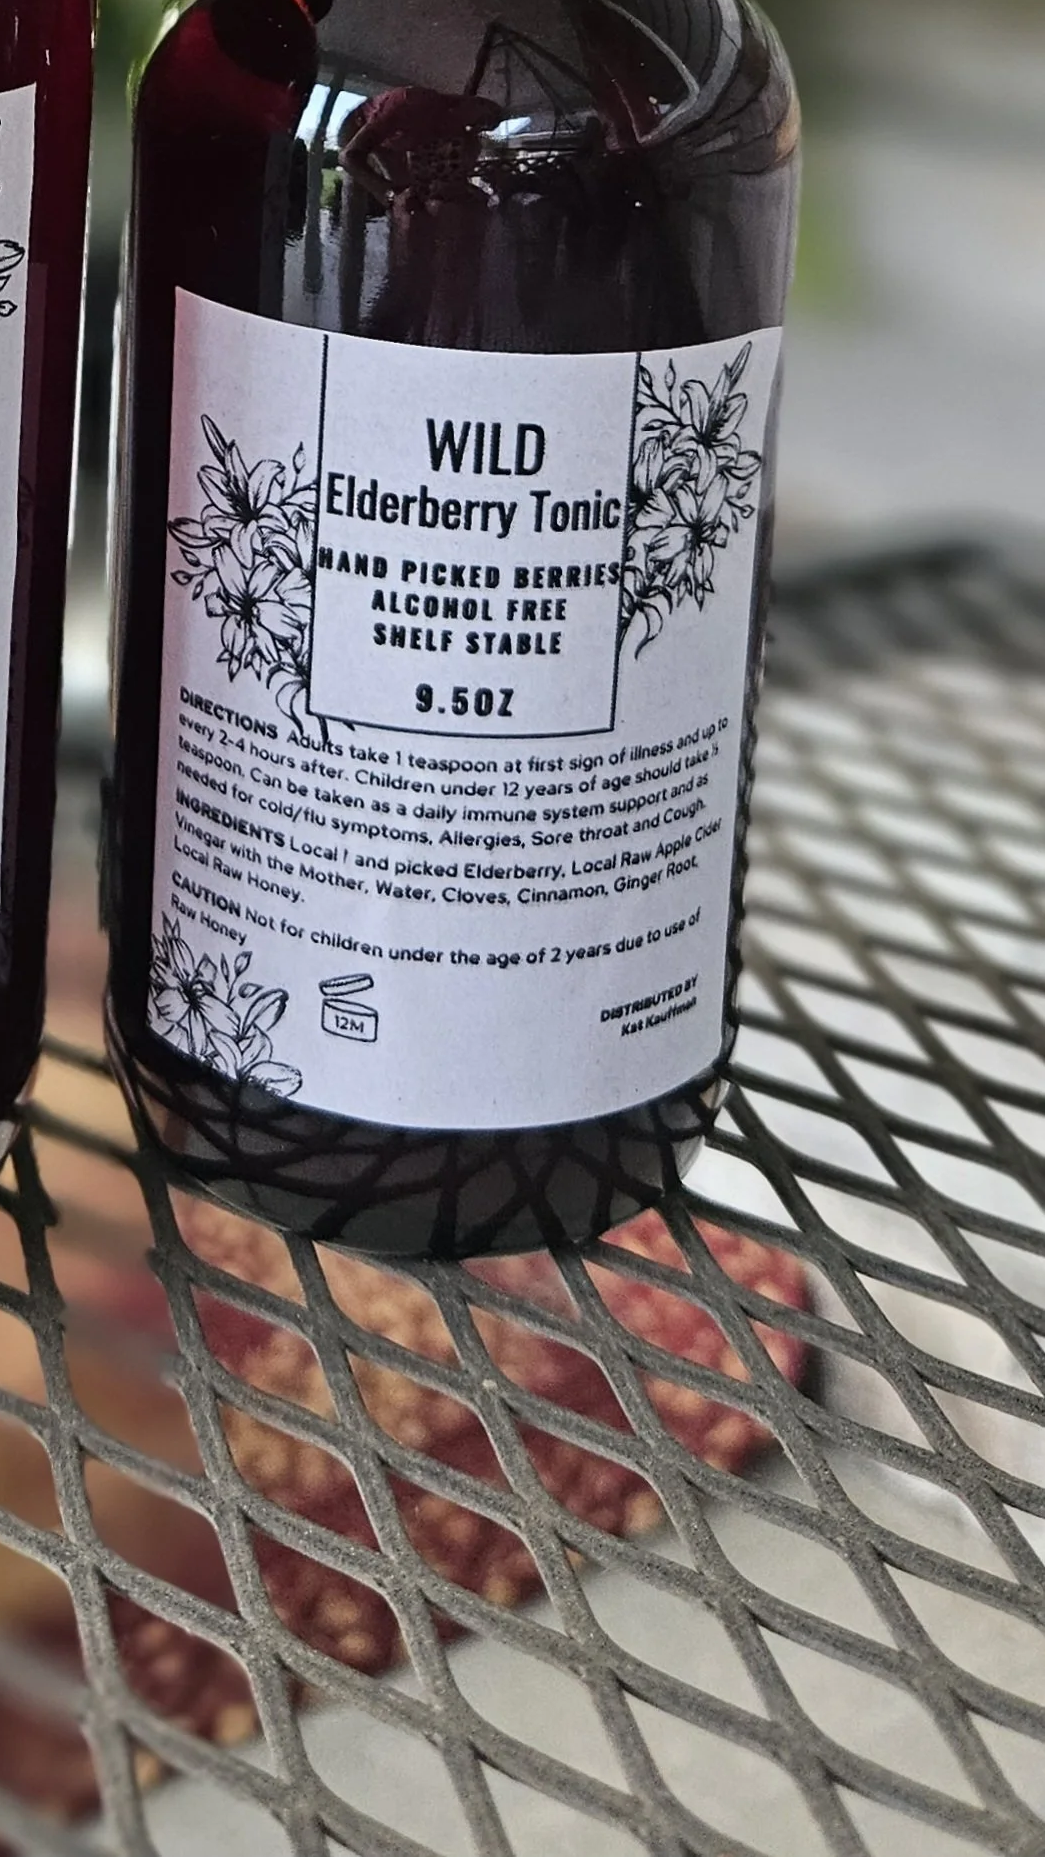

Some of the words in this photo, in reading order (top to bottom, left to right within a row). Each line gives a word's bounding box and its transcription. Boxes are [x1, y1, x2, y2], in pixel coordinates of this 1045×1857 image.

[426, 418, 546, 476] WILD
[325, 472, 518, 538] Elderberry
[531, 488, 622, 535] Tonic
[318, 546, 388, 579] HAND
[400, 561, 501, 588] PICKED
[514, 561, 622, 590] BERRIES
[371, 590, 494, 621] ALCOHOL
[507, 598, 567, 622] FREE
[373, 623, 454, 652] SHELF
[466, 630, 562, 655] STABLE
[177, 759, 227, 795] needed
[231, 783, 254, 804] for
[259, 796, 326, 826] cold/flu
[531, 828, 573, 846] Sore
[579, 821, 628, 843] throat
[633, 812, 660, 833] and
[174, 835, 209, 867] Local
[213, 856, 243, 881] Raw
[175, 810, 226, 849] Vinegar
[230, 842, 262, 864] with
[267, 855, 295, 875] the
[614, 869, 663, 893] Ginger
[170, 893, 197, 921] Raw
[200, 910, 247, 947] Honey
[172, 869, 241, 917] CAUTION
[245, 907, 276, 931] Not
[280, 918, 305, 939] for
[310, 930, 383, 958] children
[388, 946, 444, 963] under
[450, 949, 481, 965] the
[486, 951, 521, 969] age
[526, 946, 547, 964] of
[550, 947, 561, 963] 2
[566, 943, 611, 965] years
[615, 934, 644, 953] due
[646, 929, 661, 944] to
[664, 919, 686, 938] use
[688, 906, 701, 926] of
[334, 1013, 364, 1033] 12M
